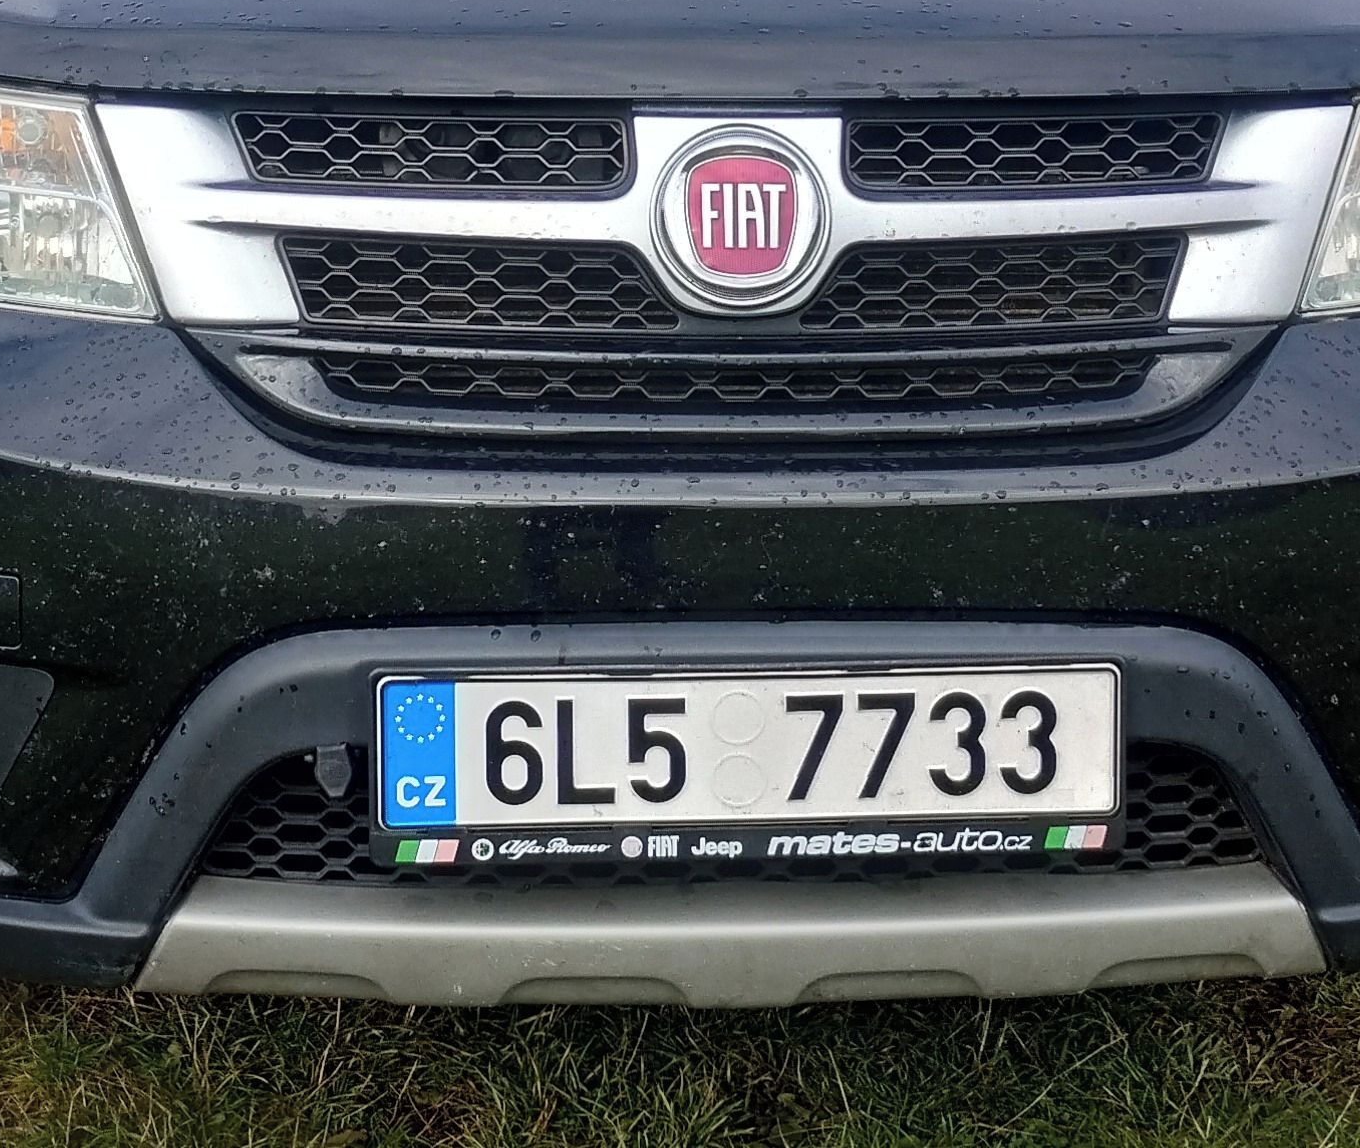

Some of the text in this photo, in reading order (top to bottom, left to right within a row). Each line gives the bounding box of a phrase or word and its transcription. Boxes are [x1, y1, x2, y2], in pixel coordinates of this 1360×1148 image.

[701, 183, 787, 249] FIAT
[486, 689, 1058, 806] 6L5 7733
[396, 774, 447, 808] CZ
[499, 837, 545, 860] Alfa
[545, 836, 612, 855] Romeo
[647, 835, 680, 858] FIAT
[690, 837, 743, 859] Jeep
[766, 828, 1034, 857] mates-auto.cz
